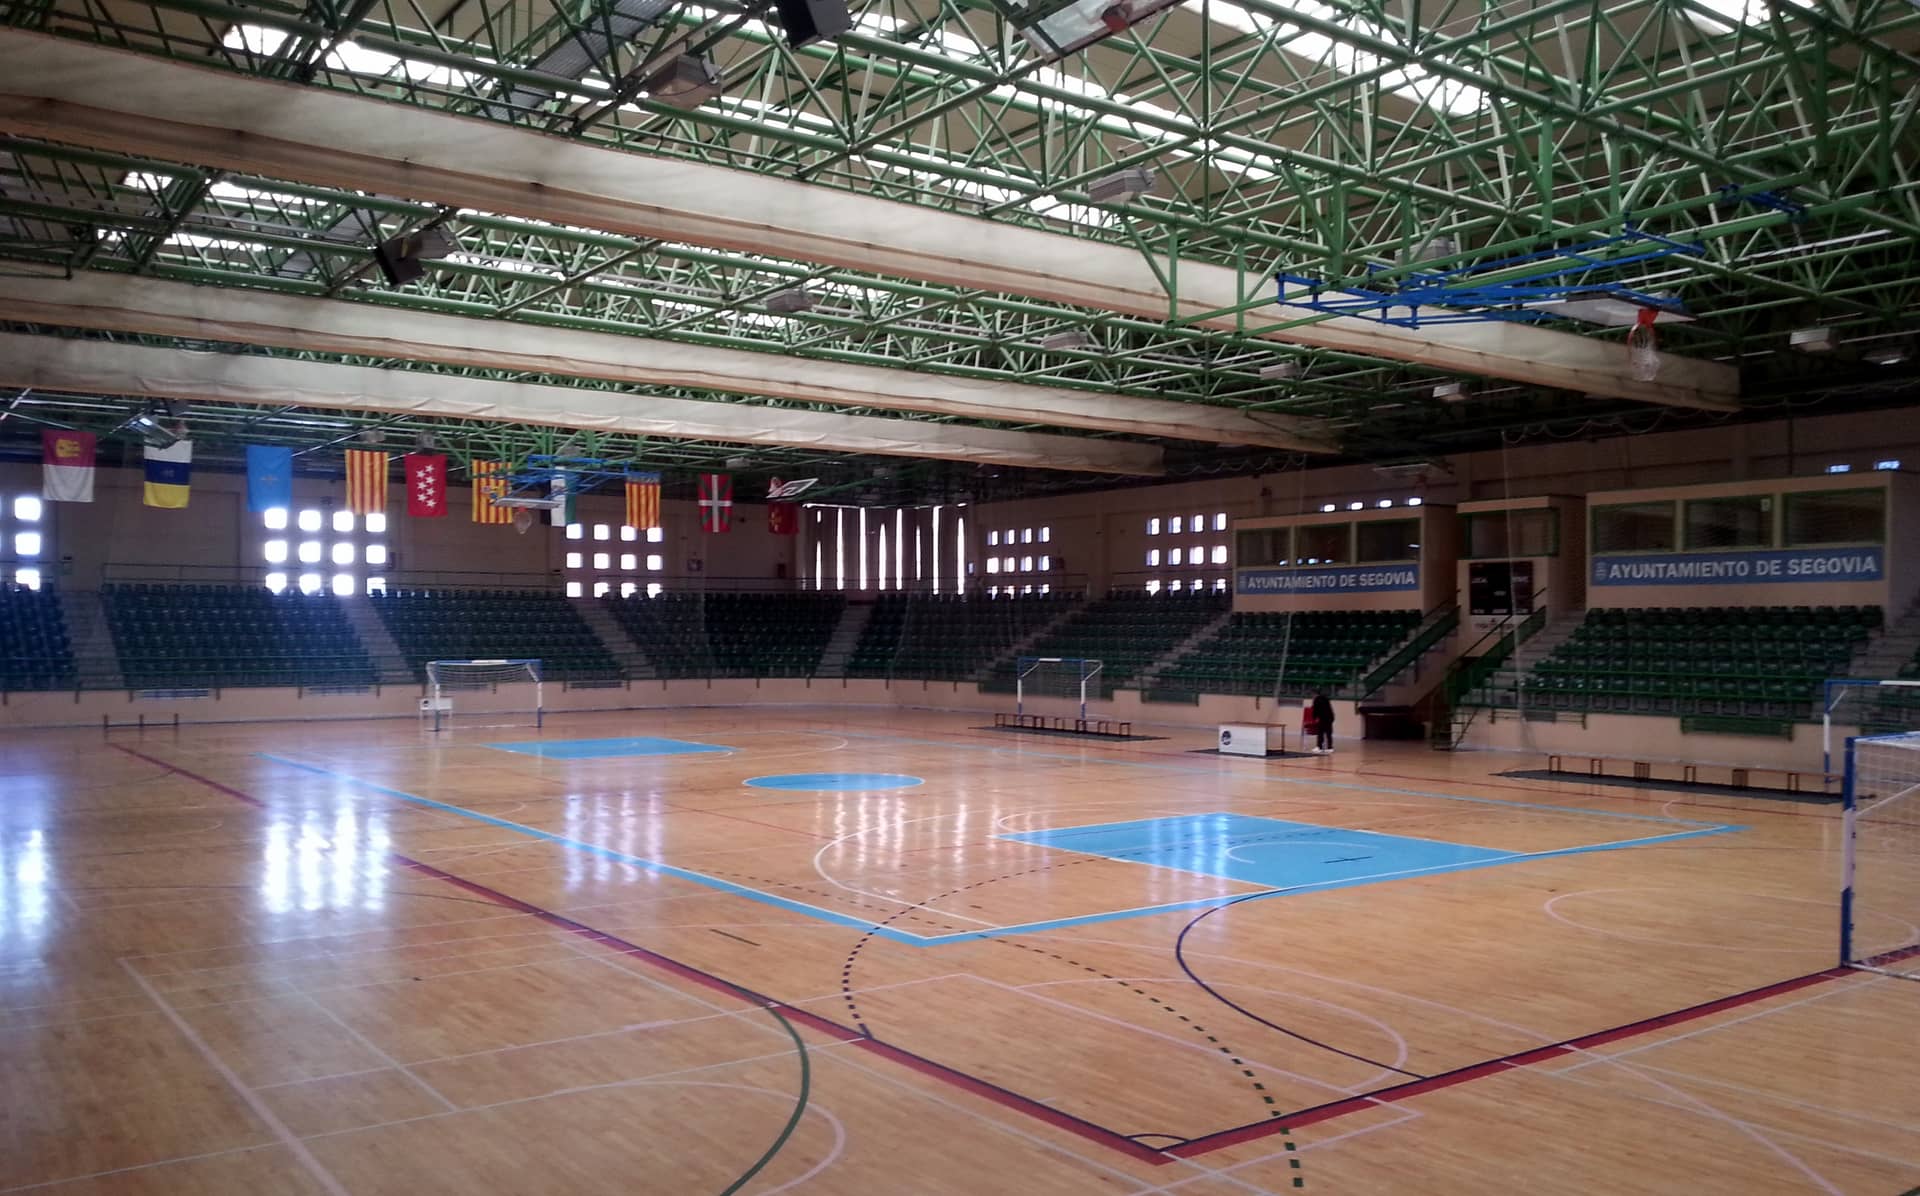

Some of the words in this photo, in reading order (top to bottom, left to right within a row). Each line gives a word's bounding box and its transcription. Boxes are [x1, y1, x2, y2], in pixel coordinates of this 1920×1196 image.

[1608, 561, 1750, 578] AYUNTAMIENTO
[1756, 560, 1782, 576] DE
[1787, 556, 1878, 575] SEGOVIA
[1248, 574, 1336, 589] AYUNTAMIENTO
[1339, 574, 1357, 587] DE
[1359, 571, 1416, 587] SEGOVIA
